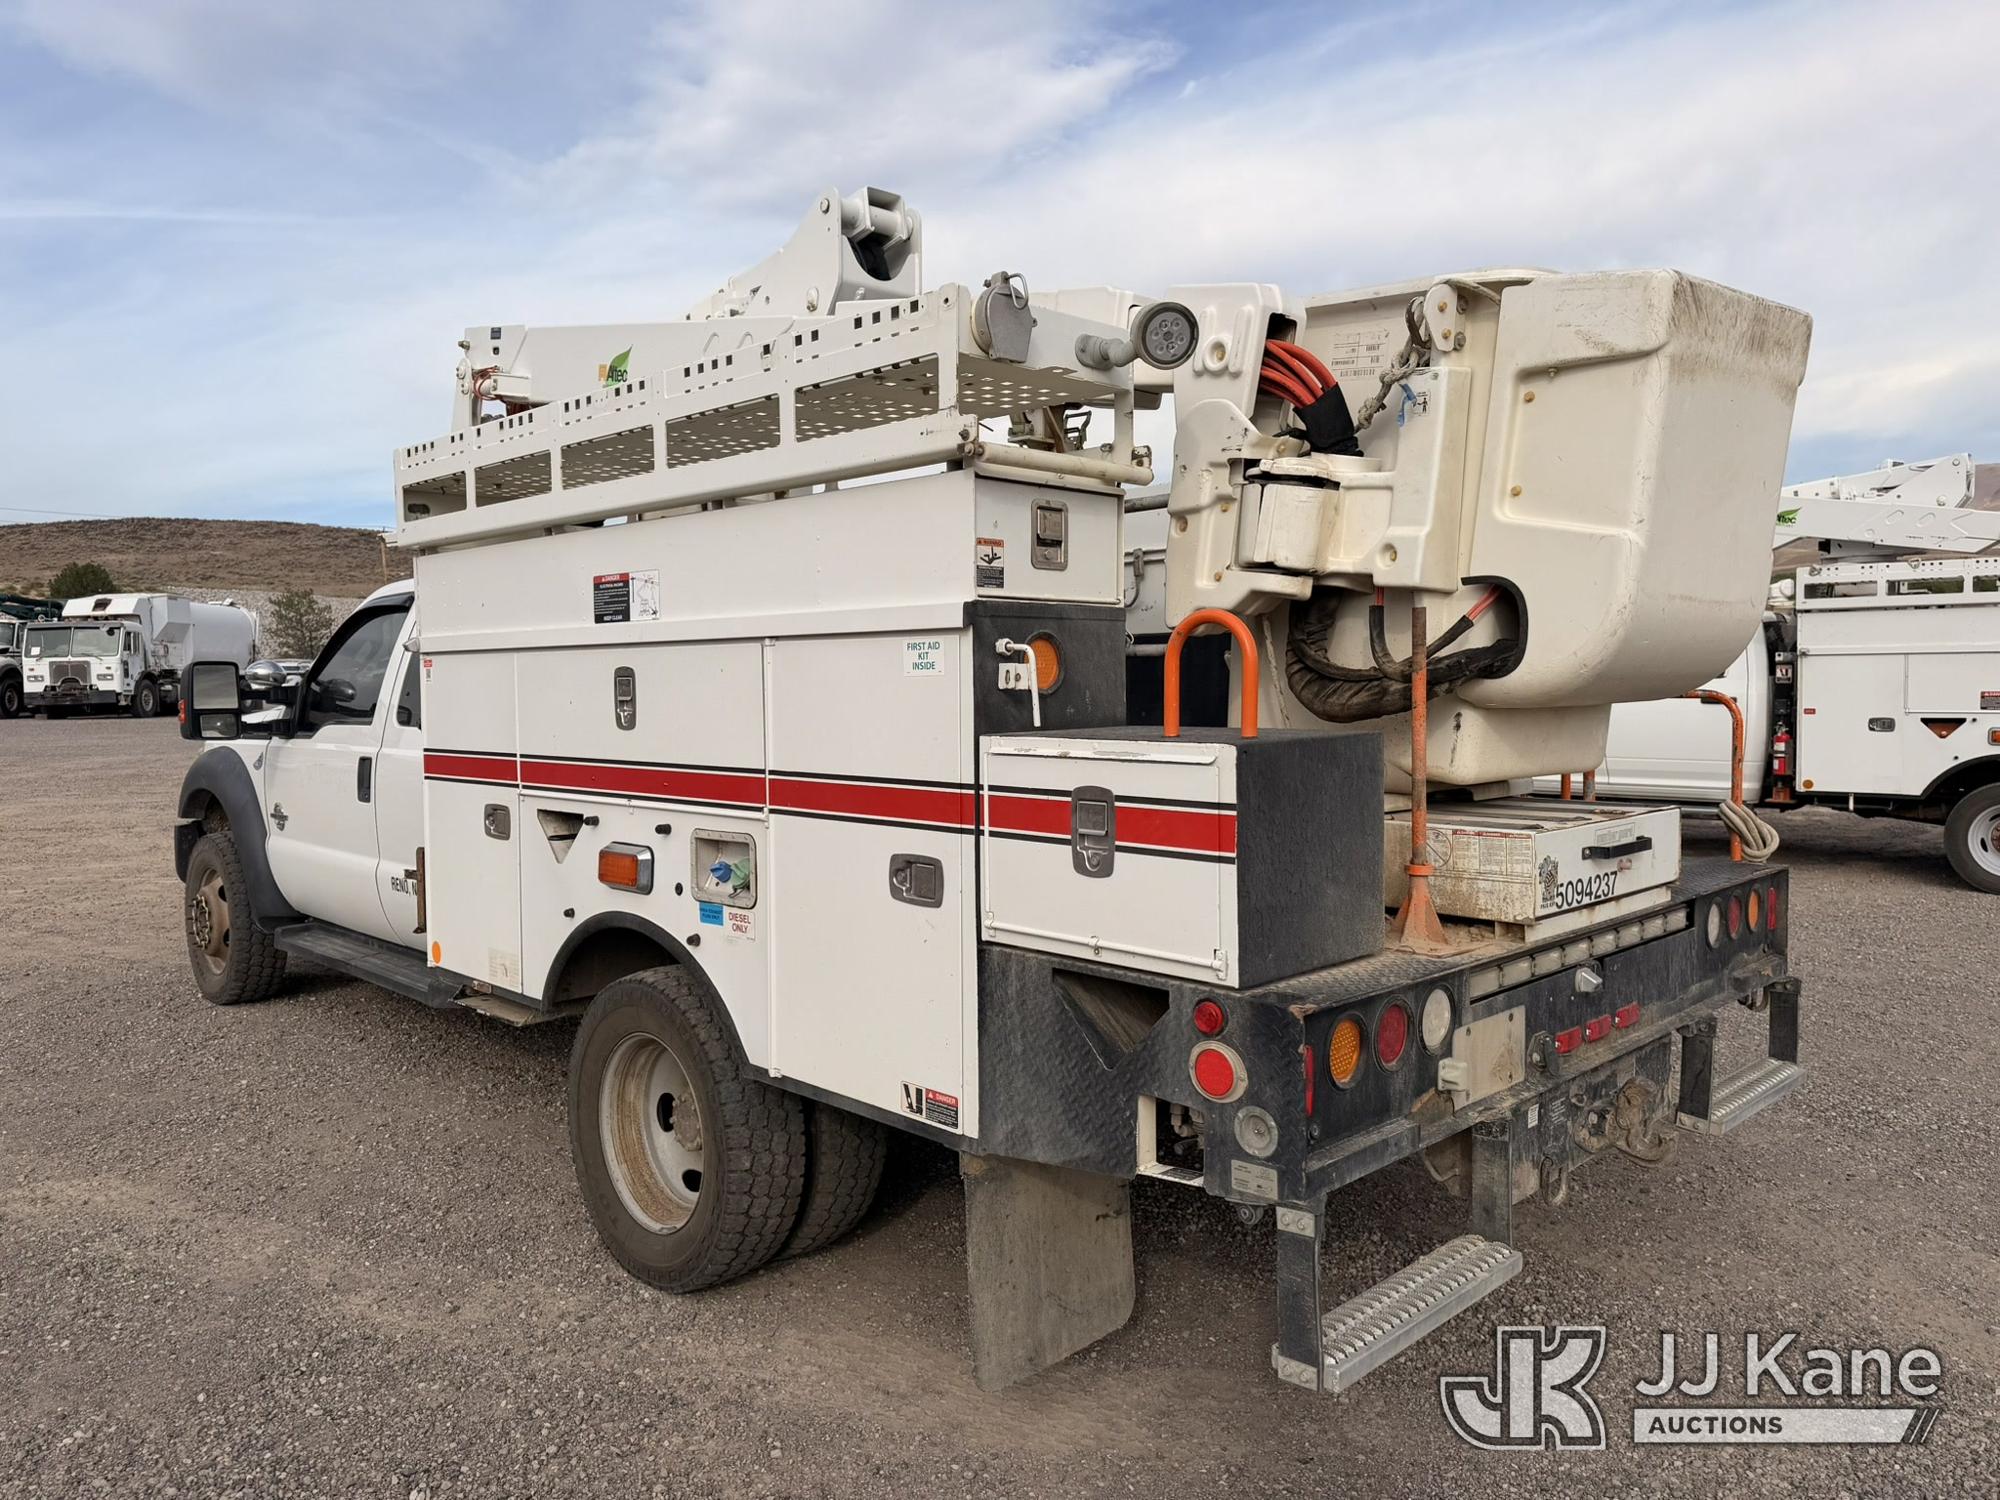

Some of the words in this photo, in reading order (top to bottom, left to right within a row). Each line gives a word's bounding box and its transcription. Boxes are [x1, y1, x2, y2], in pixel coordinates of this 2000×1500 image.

[906, 642, 926, 651] FIRST
[927, 641, 941, 650] AID
[917, 651, 929, 660] KIT
[912, 661, 936, 670] INSIDE
[391, 876, 411, 896] RENO,
[1555, 870, 1618, 909] 5094237
[728, 912, 751, 924] DIESEL
[732, 923, 748, 933] ONLY
